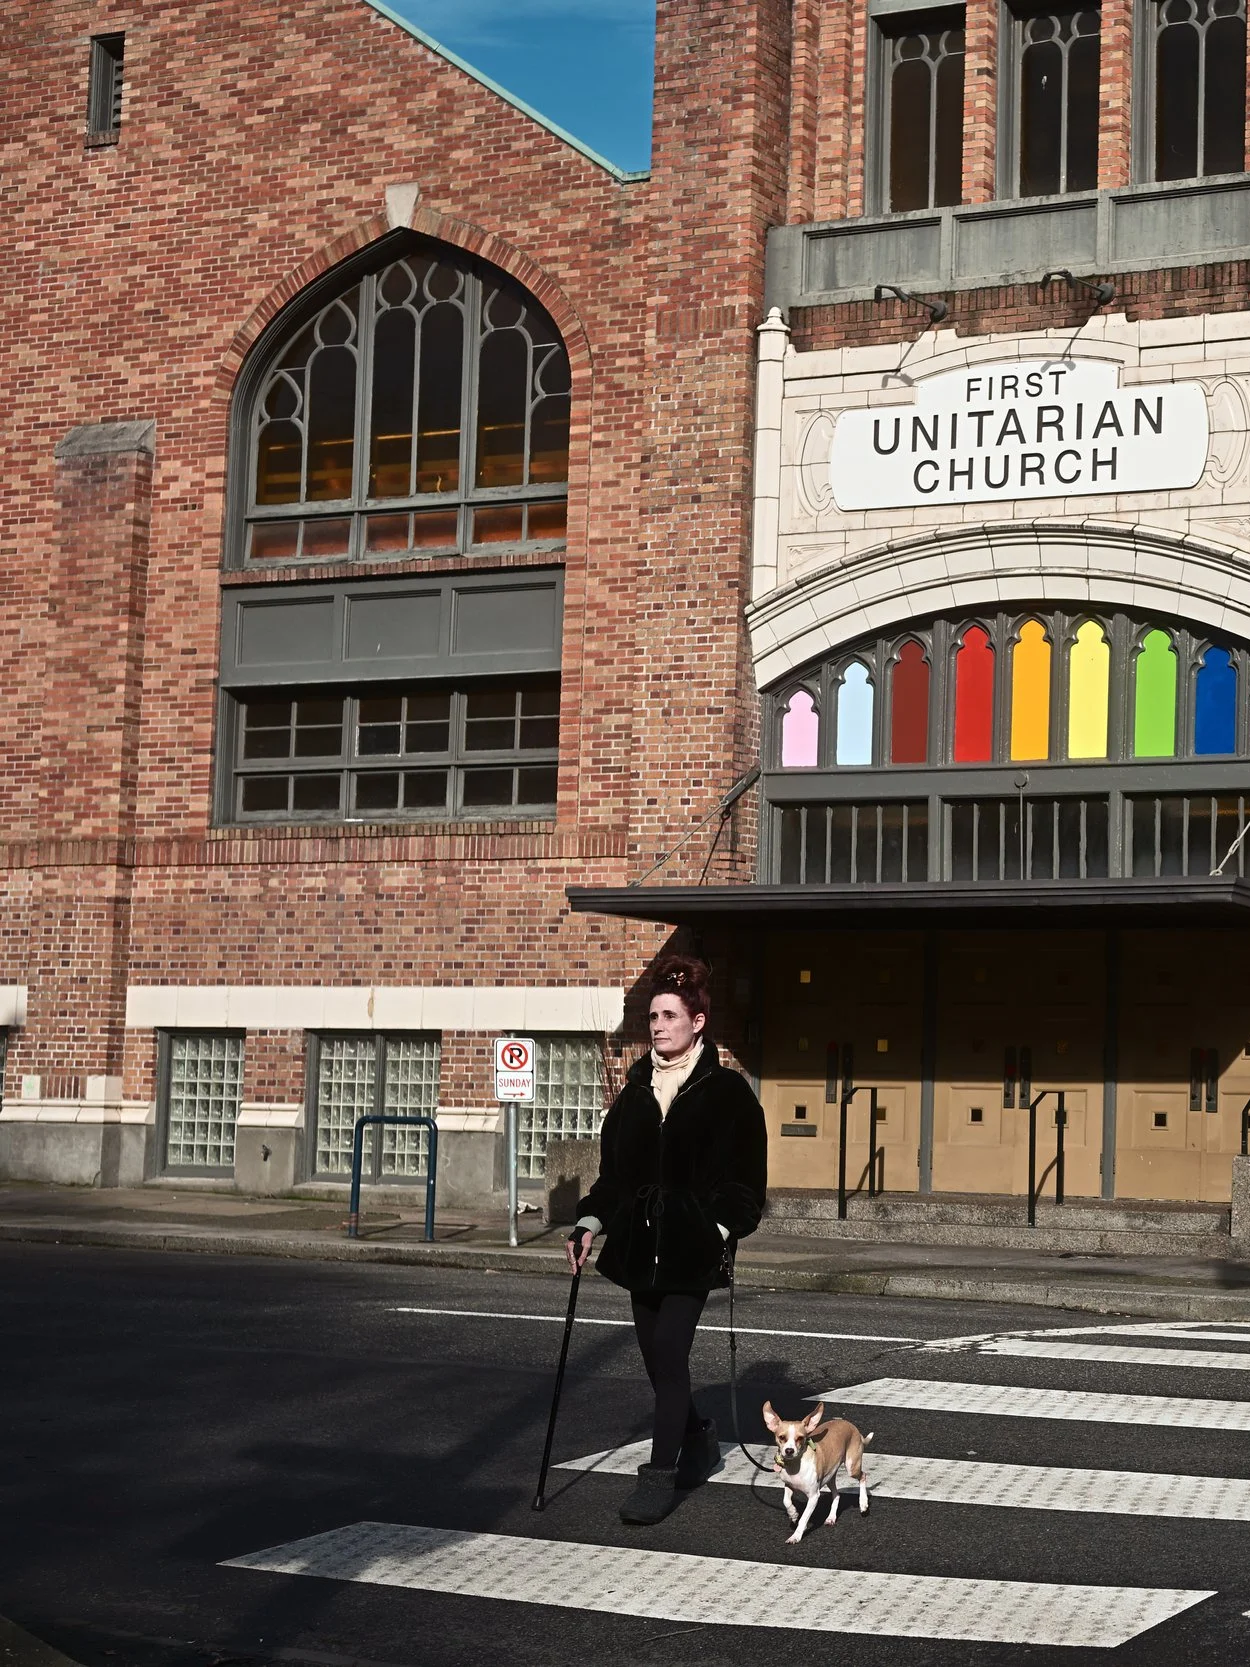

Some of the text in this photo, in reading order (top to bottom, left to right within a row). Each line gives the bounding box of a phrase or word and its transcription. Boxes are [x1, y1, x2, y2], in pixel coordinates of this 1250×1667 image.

[966, 370, 1067, 402] FIRST
[873, 396, 1164, 455] UNITARIAN
[913, 446, 1118, 494] CHURCH
[498, 1078, 531, 1088] SUNDAY
